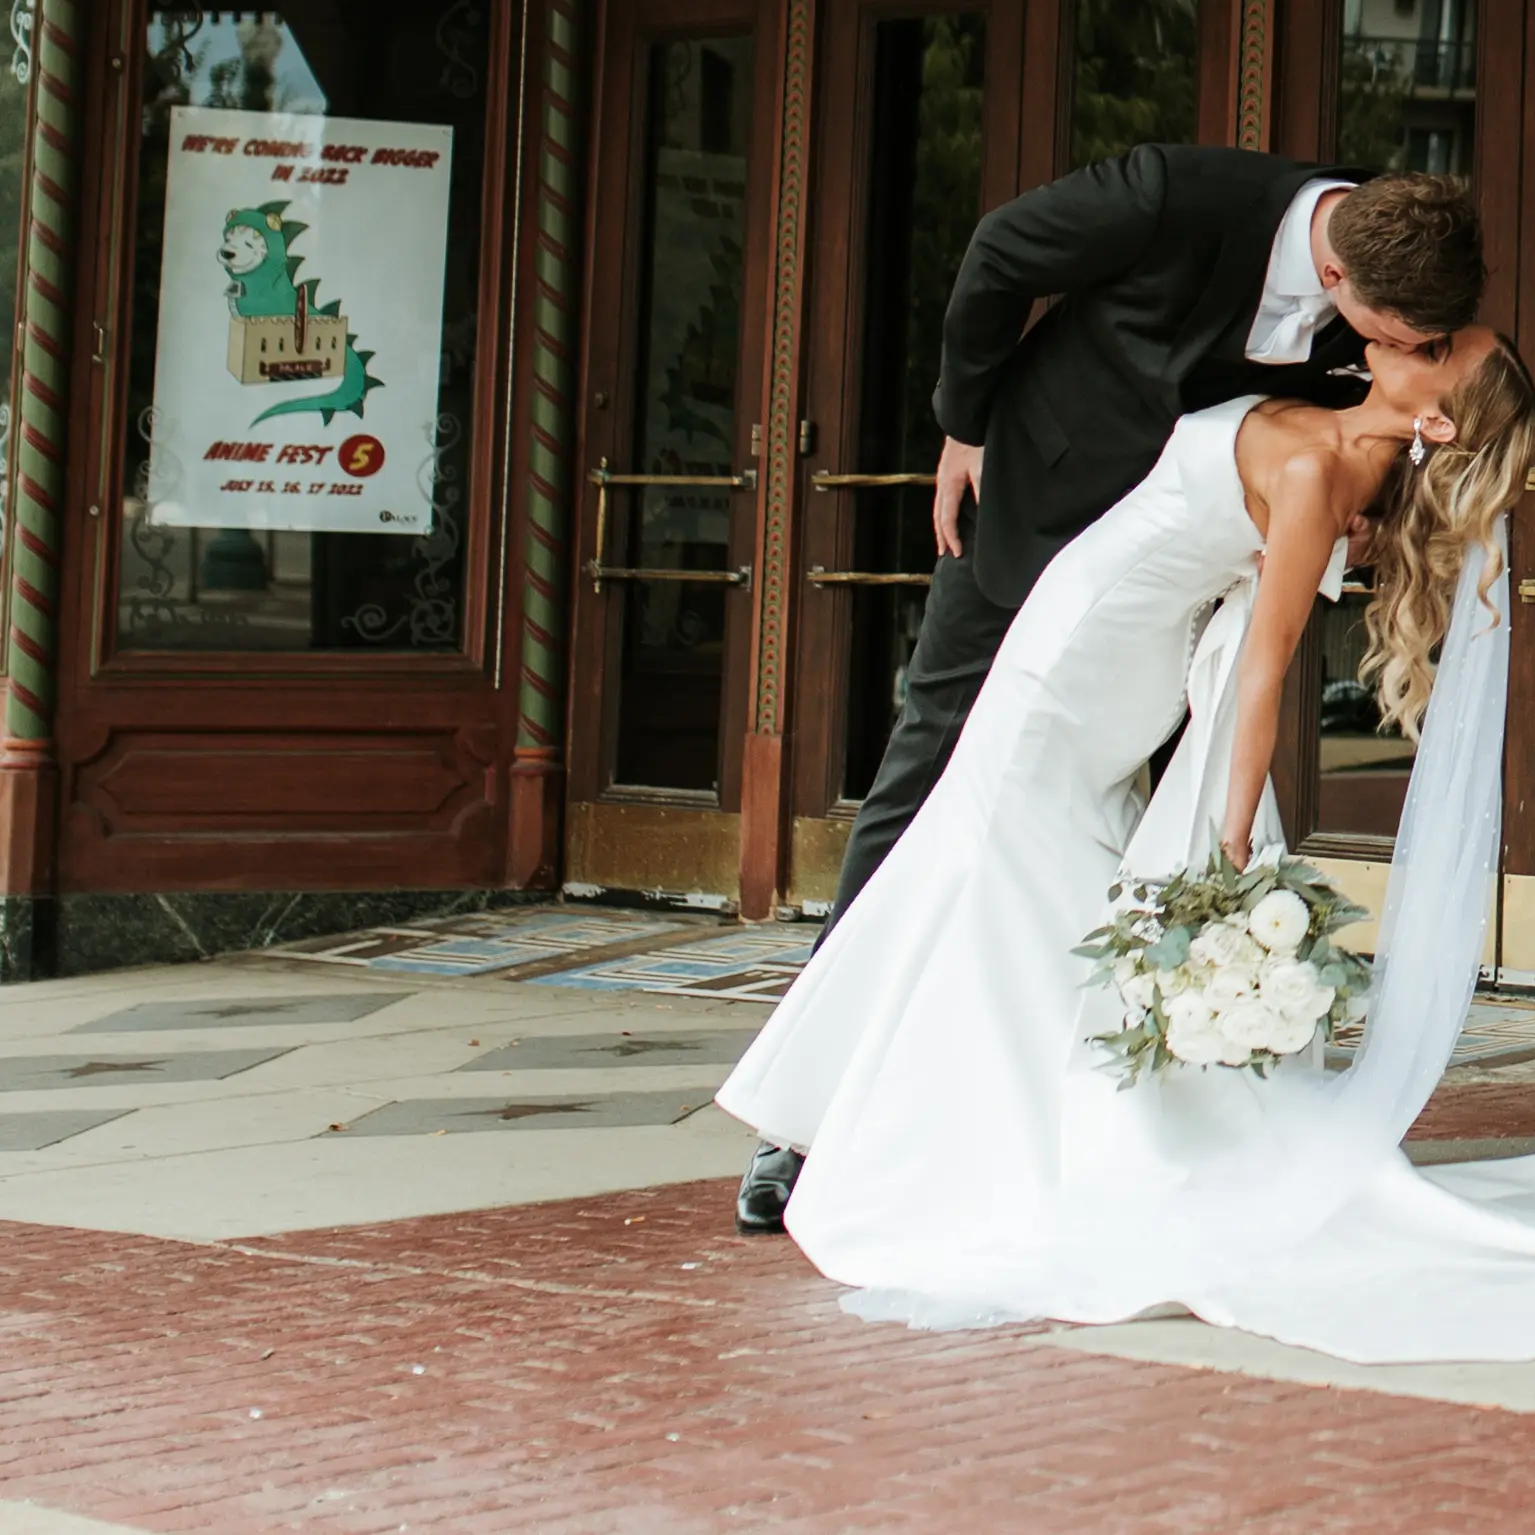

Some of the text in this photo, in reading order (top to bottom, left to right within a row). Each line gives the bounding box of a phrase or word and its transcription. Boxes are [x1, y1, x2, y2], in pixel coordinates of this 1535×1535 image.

[181, 135, 239, 154] WE'RE
[321, 145, 368, 164] BACK
[371, 148, 439, 169] BIGGER
[271, 165, 294, 182] IN
[203, 440, 375, 470] ANIME FEST 5
[220, 479, 254, 492] JULY
